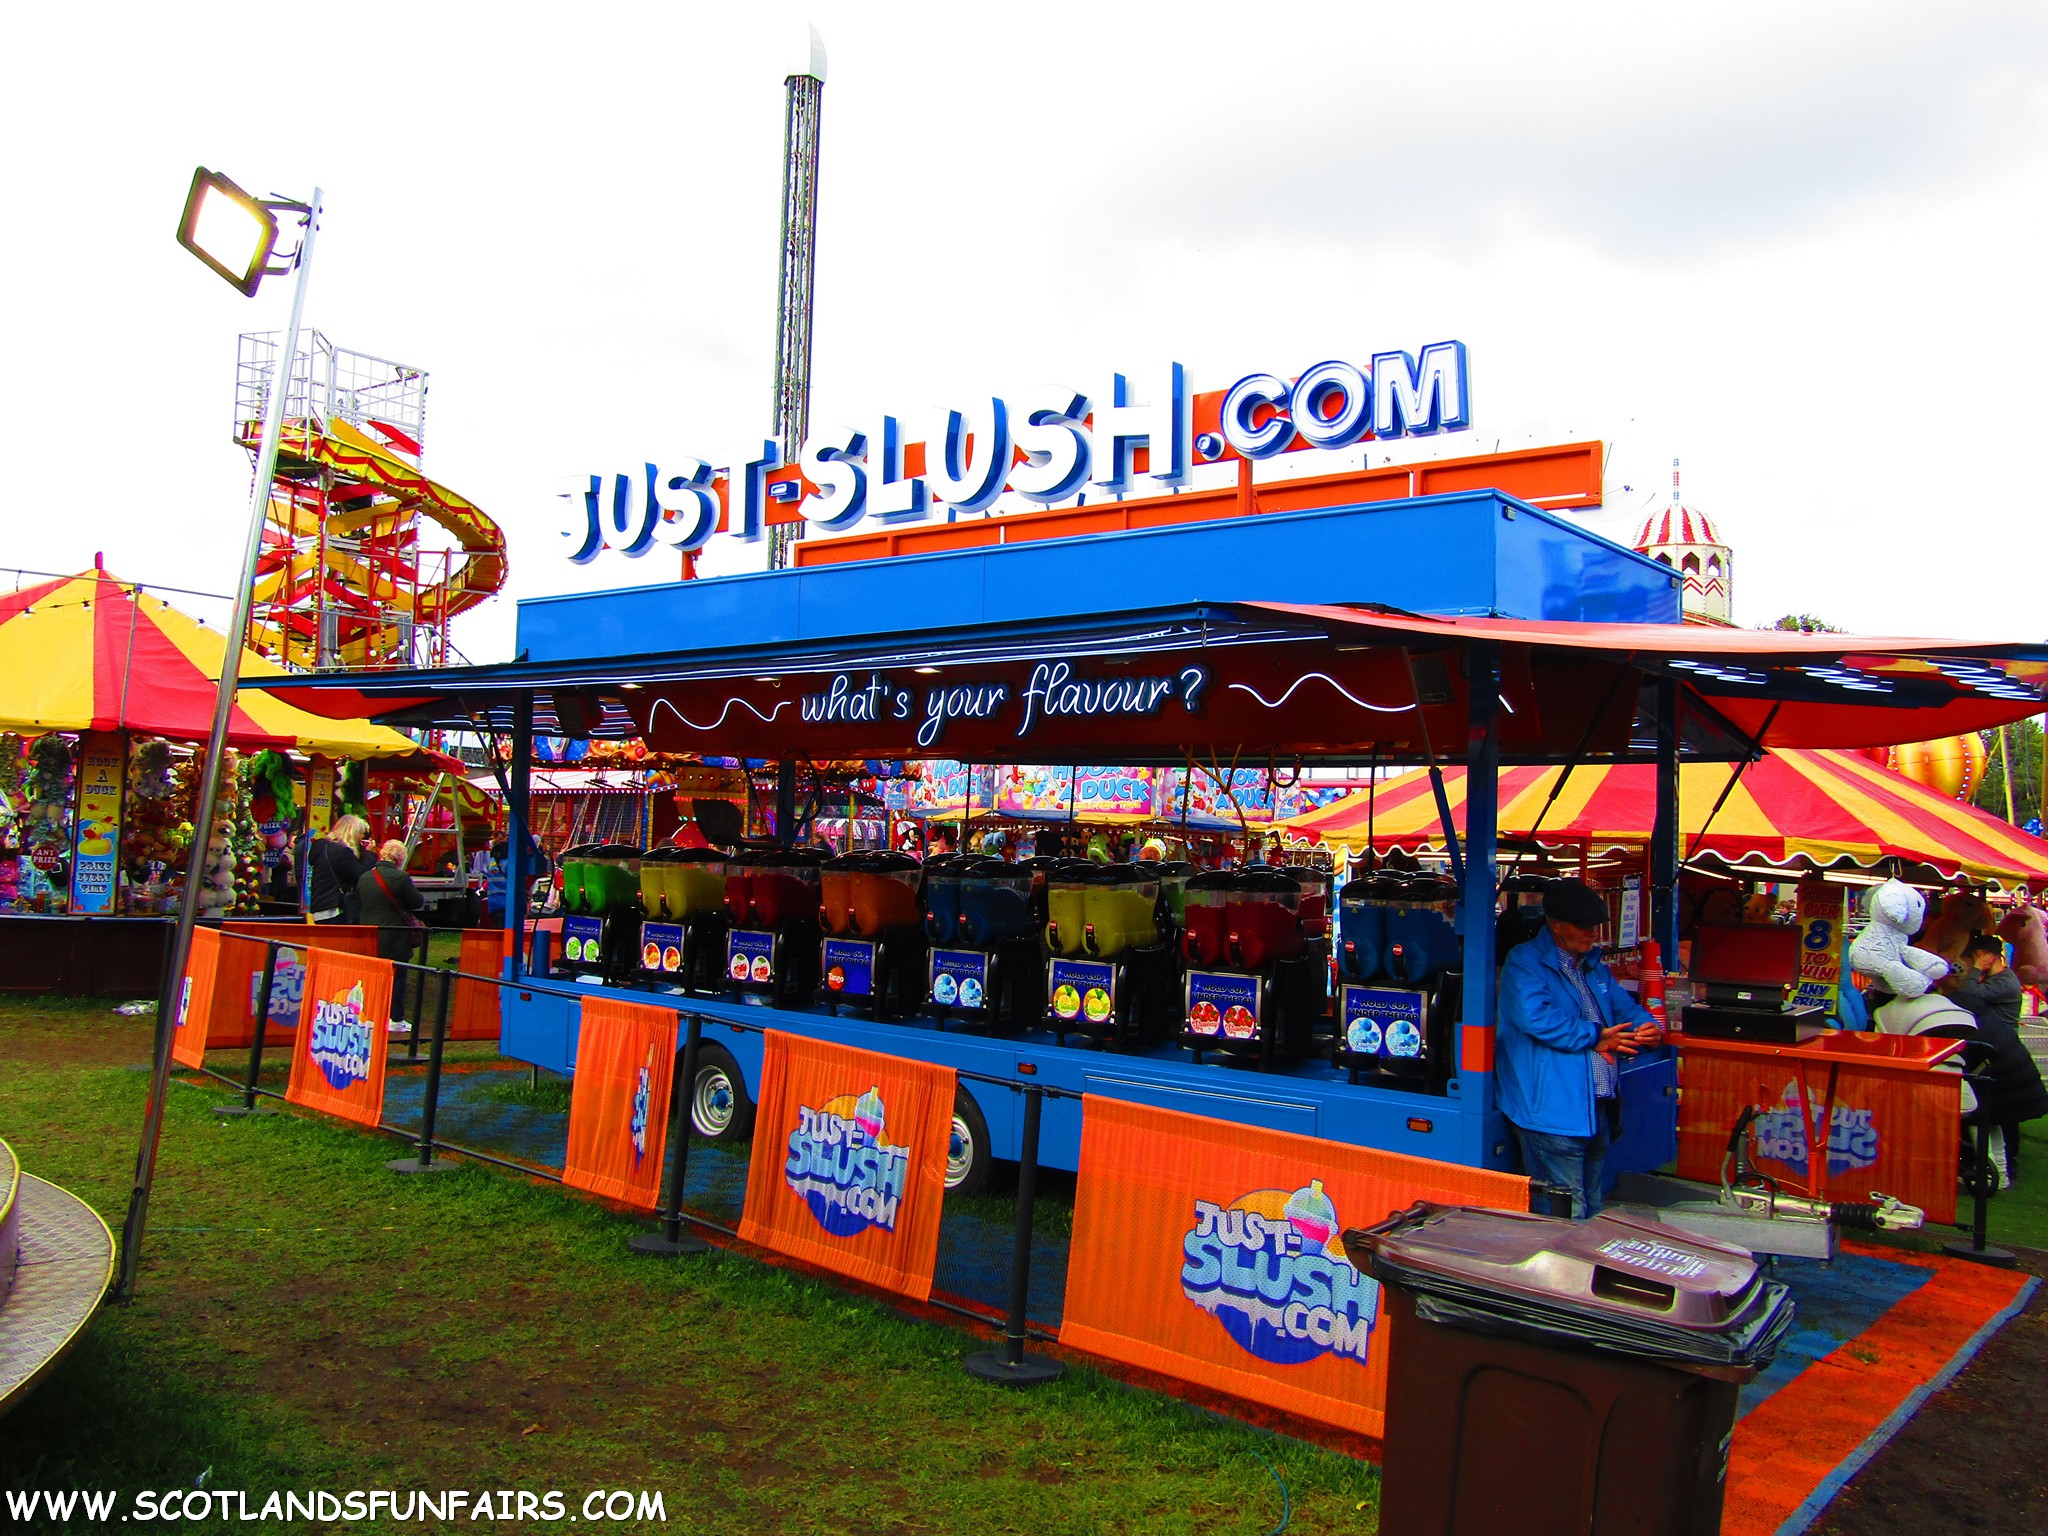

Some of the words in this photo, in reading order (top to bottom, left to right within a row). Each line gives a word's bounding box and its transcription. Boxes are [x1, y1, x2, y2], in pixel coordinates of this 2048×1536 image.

[556, 340, 1470, 565] JUST-SLUSH.COM
[801, 674, 908, 722] what's
[917, 686, 1004, 746] your
[87, 757, 119, 767] HOOK
[96, 769, 108, 782] A
[85, 785, 117, 795] DUCK
[1082, 777, 1149, 801] DUCK
[1215, 793, 1229, 808] A
[79, 861, 112, 871] PRIZE
[77, 873, 111, 883] EVERY
[81, 884, 107, 894] TIME
[1804, 902, 1840, 918] OVER
[1804, 919, 1832, 950] 8
[1804, 952, 1831, 965] TO
[828, 973, 844, 983] Tango
[1064, 971, 1085, 979] HOLD
[1800, 964, 1836, 979] WIN
[1203, 984, 1227, 992] HOLD
[1229, 986, 1246, 994] CUP
[1798, 983, 1831, 997] ANY
[1192, 992, 1220, 1000] UNDER
[1221, 995, 1236, 1003] THE
[1237, 996, 1254, 1004] TAP
[1361, 1000, 1387, 1008] HOLD
[1389, 1002, 1410, 1010] CUP
[1792, 995, 1834, 1011] PRIZE
[1348, 1007, 1380, 1017] UNDER
[1381, 1011, 1399, 1019] THE
[1401, 1012, 1419, 1020] TAP
[312, 1018, 374, 1058] SLUSH
[799, 1105, 863, 1148] JUST-
[787, 1129, 909, 1200] SLUSH
[841, 1186, 898, 1228] .COM
[1195, 1199, 1301, 1256] JUST-
[1181, 1228, 1380, 1325] SLUSH
[1276, 1302, 1369, 1359] .COM
